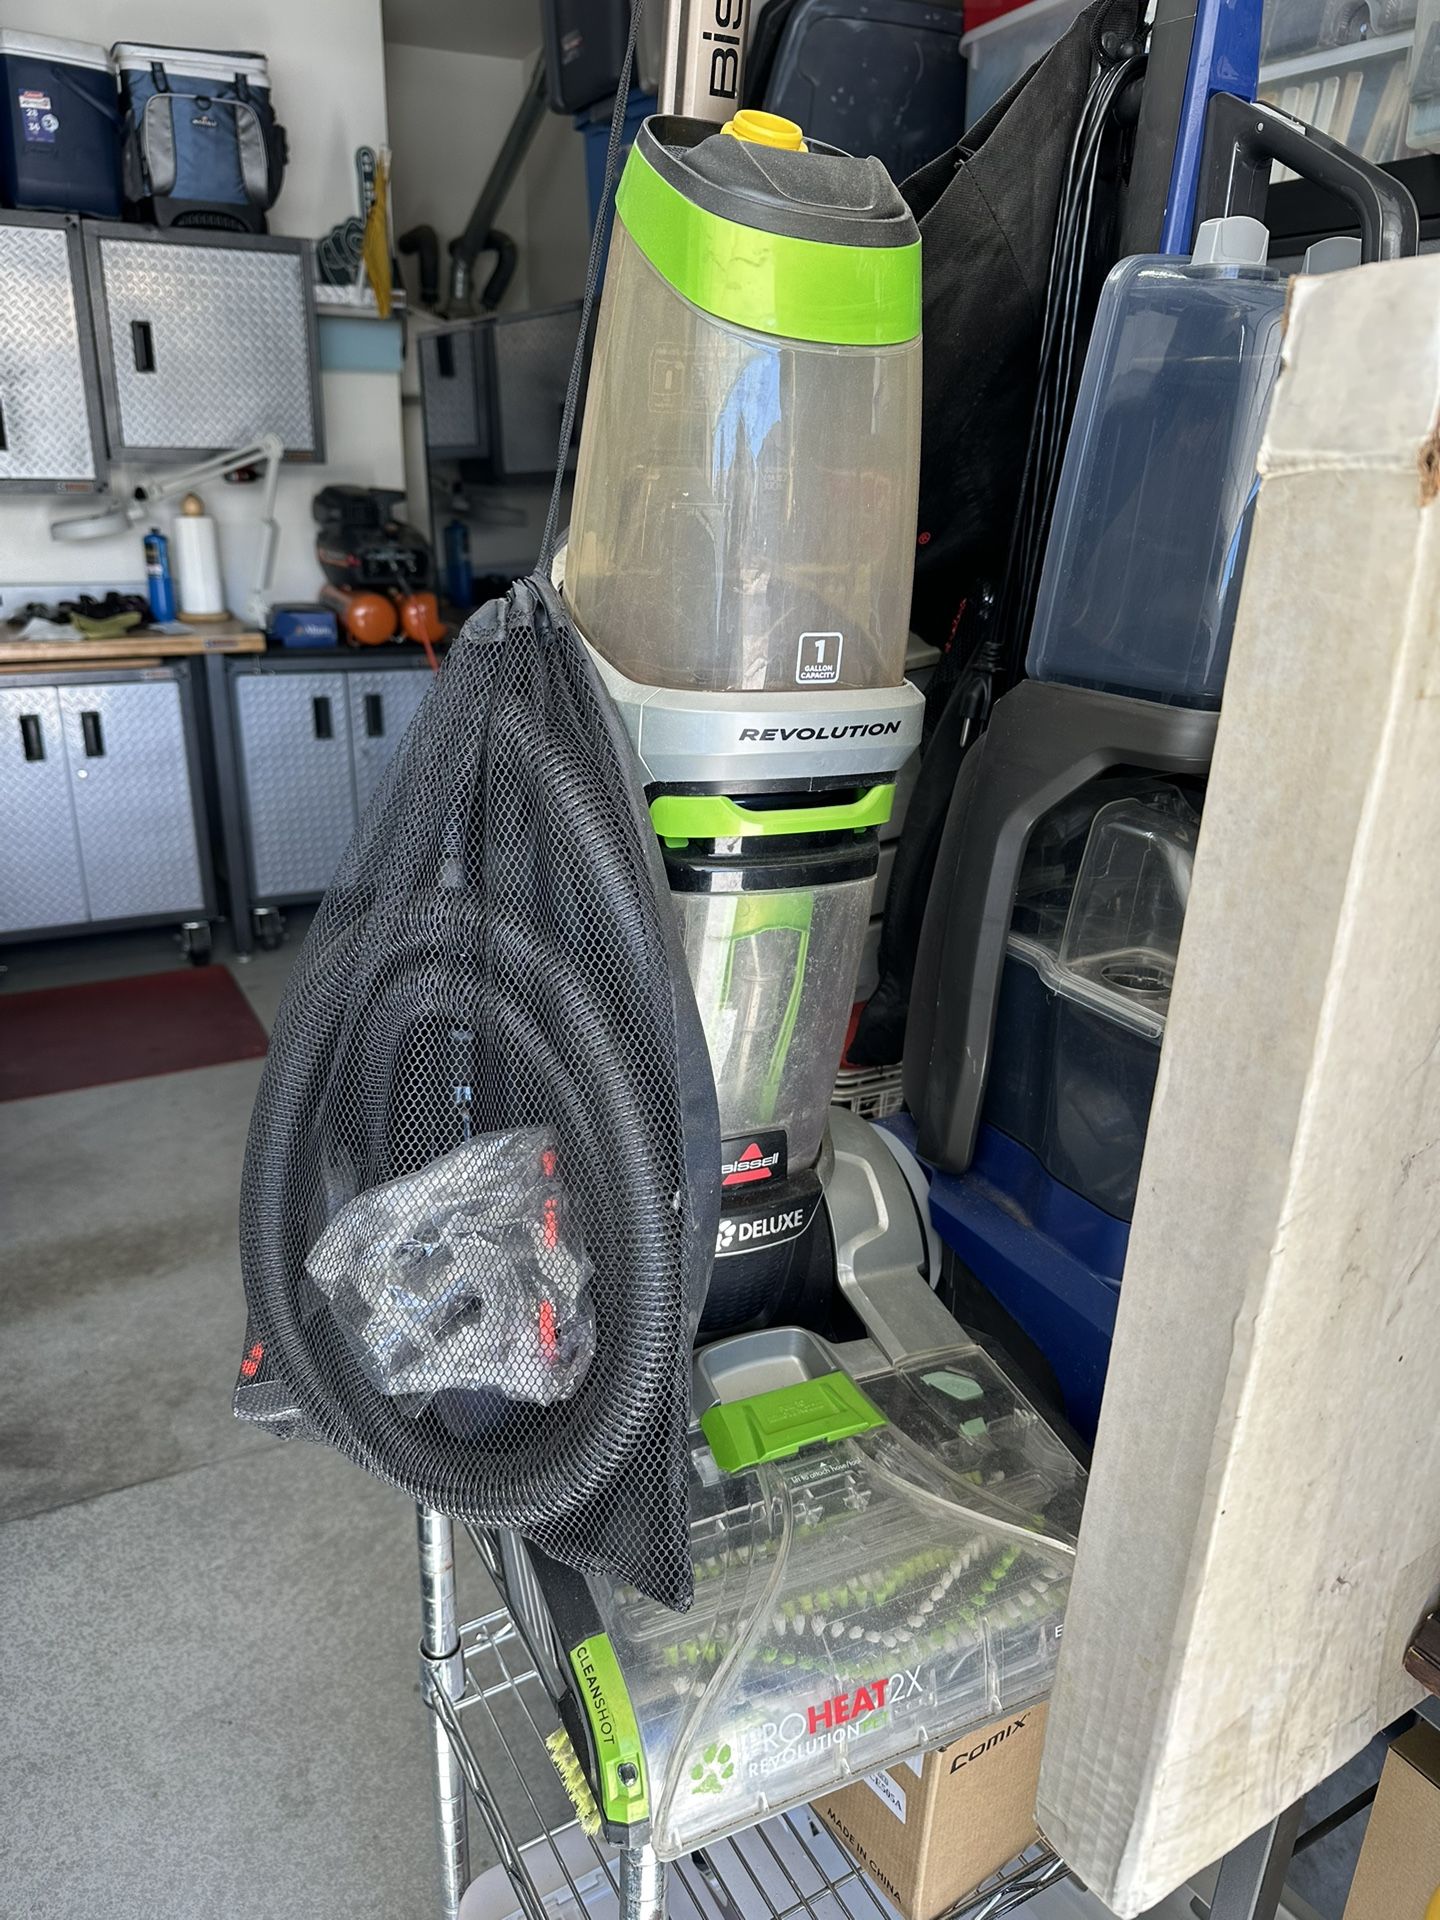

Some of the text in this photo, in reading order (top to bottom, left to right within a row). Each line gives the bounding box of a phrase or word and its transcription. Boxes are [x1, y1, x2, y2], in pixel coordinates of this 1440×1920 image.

[814, 639, 826, 664] 1
[800, 671, 836, 679] CAPACITY
[804, 664, 833, 672] GALLON
[738, 720, 902, 741] REVOLUTION
[738, 1209, 804, 1241] DELUXE
[576, 1646, 616, 1745] CLEANSHOT
[749, 1722, 862, 1778] REVOLUTION
[827, 1807, 902, 1904] MADE IN CHINA
